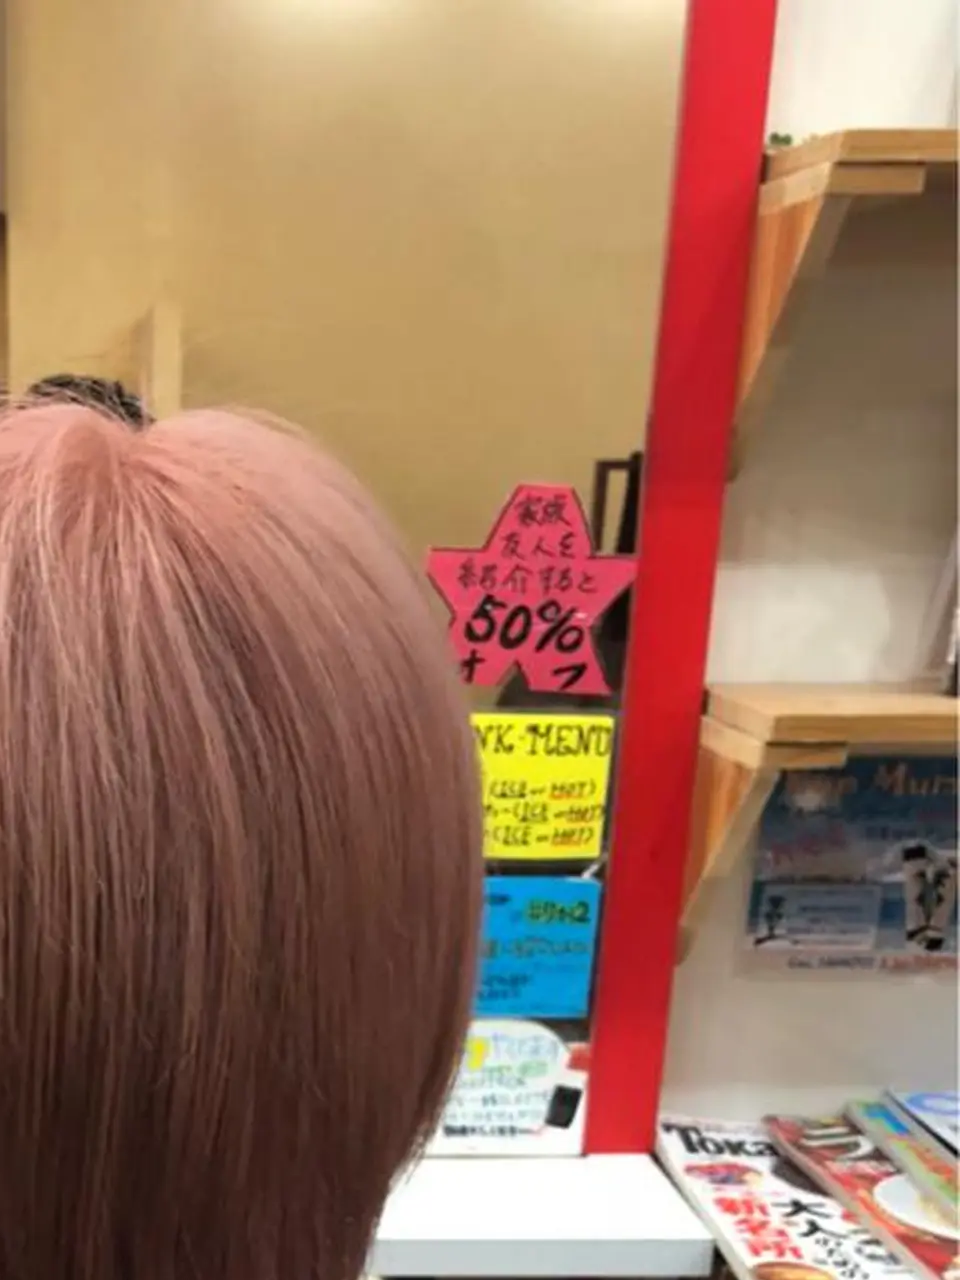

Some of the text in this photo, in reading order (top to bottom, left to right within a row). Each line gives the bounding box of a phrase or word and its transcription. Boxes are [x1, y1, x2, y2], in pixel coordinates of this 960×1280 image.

[501, 530, 576, 561] 友人を
[457, 557, 596, 595] 紹介すると
[464, 593, 585, 654] 50%
